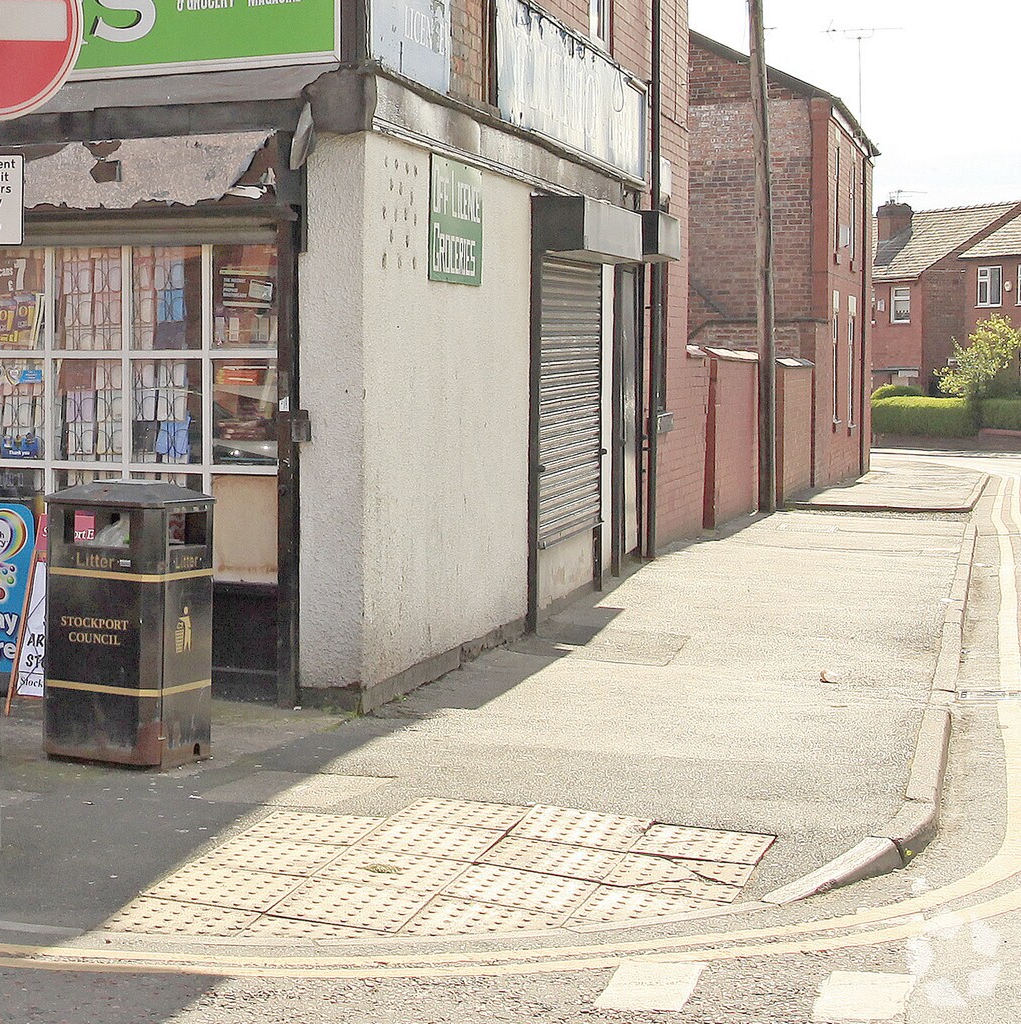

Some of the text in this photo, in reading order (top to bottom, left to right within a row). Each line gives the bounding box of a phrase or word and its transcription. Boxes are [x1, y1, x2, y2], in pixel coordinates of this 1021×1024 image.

[403, 5, 445, 56] LICENE
[433, 221, 477, 277] GROCERIES
[76, 552, 115, 568] Litter
[60, 616, 129, 631] STOCKPORT
[68, 631, 121, 645] COUNCIL
